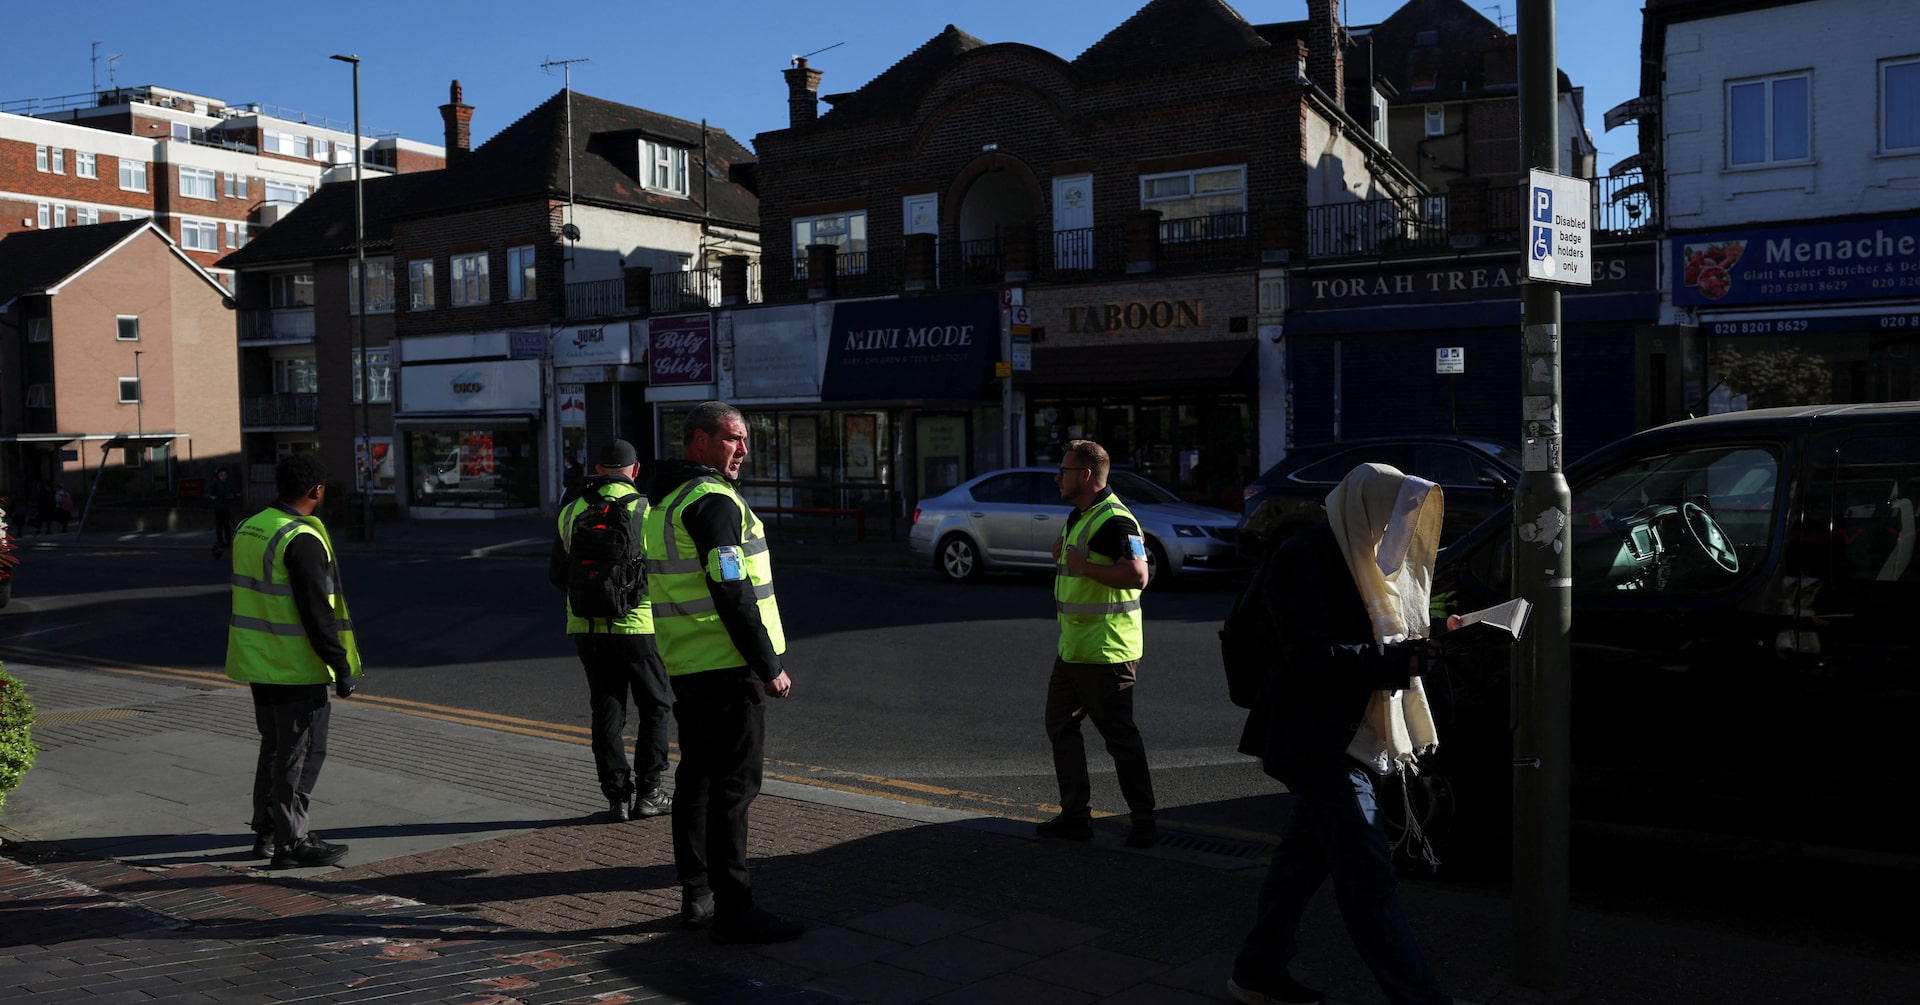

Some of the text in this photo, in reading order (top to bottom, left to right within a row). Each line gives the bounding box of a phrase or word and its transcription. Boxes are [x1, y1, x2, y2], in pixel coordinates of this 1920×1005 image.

[1537, 191, 1550, 219] P
[1555, 215, 1586, 230] Disabled
[1559, 230, 1582, 244] badge
[1557, 245, 1584, 258] holders
[1765, 229, 1920, 264] Menache
[1562, 261, 1578, 274] only
[1743, 270, 1774, 281] Glatt
[1778, 267, 1823, 279] Kosher
[1828, 264, 1880, 276] Butcher
[1884, 261, 1895, 273] &
[1312, 274, 1415, 299] TORAH
[1760, 280, 1848, 294] 020 8201 8629
[1872, 277, 1895, 288] 020
[1062, 299, 1201, 333] TABOON
[1880, 316, 1906, 328] 020
[1715, 320, 1809, 334] 020 8201 8629
[843, 324, 974, 351] MINI MODE
